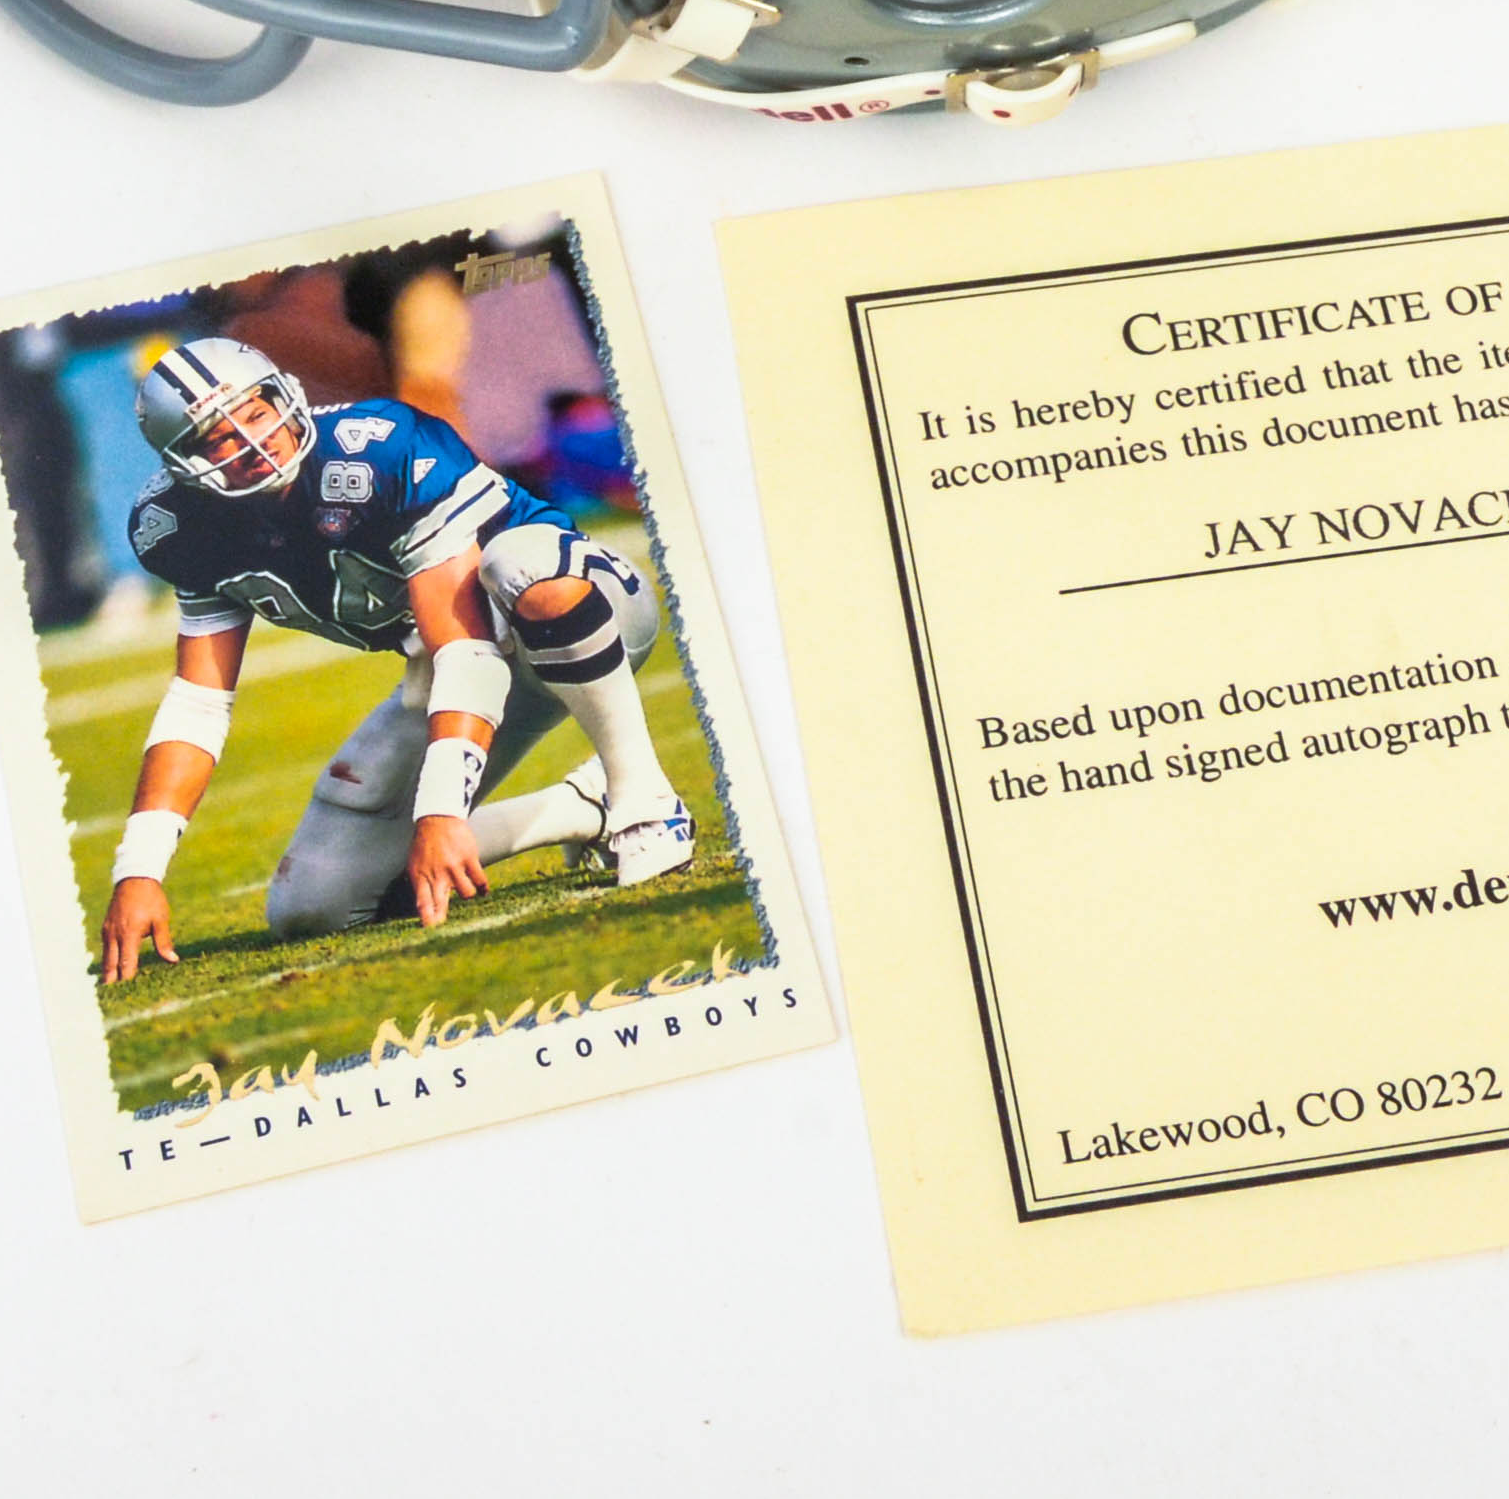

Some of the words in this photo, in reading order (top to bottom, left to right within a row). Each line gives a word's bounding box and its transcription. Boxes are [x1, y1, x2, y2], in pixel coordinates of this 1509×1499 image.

[918, 410, 949, 442] It
[964, 404, 997, 436] is
[1011, 388, 1136, 430] hereby
[1154, 364, 1308, 412] certified
[1321, 358, 1393, 391] that
[1406, 348, 1463, 380] the
[930, 435, 1168, 491] accompanies
[1180, 426, 1249, 459] this
[1261, 401, 1443, 448] document
[1203, 513, 1296, 560] JAY
[976, 703, 1097, 750] Based
[1109, 697, 1206, 739] upon
[1218, 652, 1500, 717] documentation
[988, 767, 1049, 803] the
[1057, 749, 1155, 794] hand
[1164, 729, 1291, 784] signed
[1301, 702, 1492, 760] autograph
[172, 1049, 319, 1129] Jay
[369, 939, 752, 1070] Novacek
[535, 987, 798, 1069] COWBOYS
[1056, 1099, 1287, 1165] Lakewood,
[1295, 1087, 1366, 1128] CO
[1375, 1066, 1504, 1117] 80232
